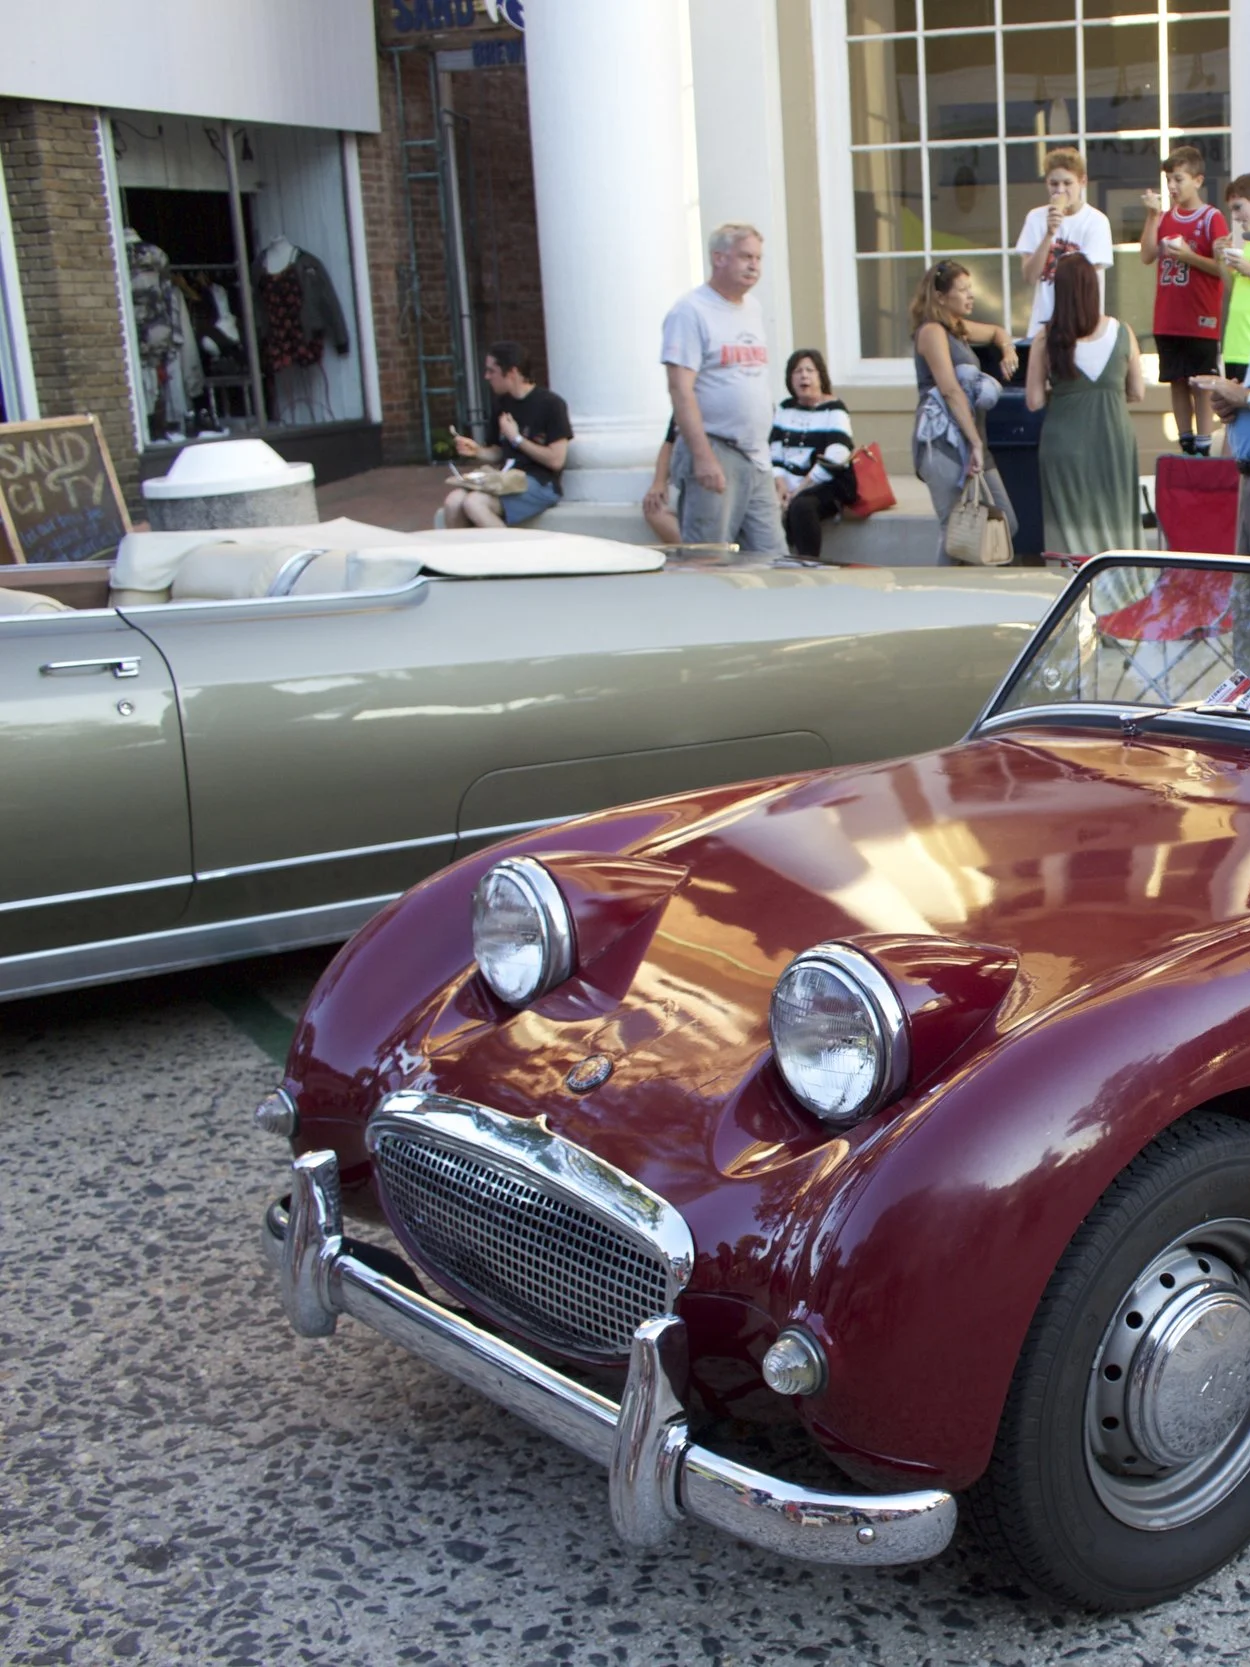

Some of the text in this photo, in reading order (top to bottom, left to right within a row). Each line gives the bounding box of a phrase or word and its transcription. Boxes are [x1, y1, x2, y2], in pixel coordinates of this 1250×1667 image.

[472, 40, 525, 67] BREW
[1160, 258, 1190, 287] 23
[0, 431, 90, 480] SAND
[8, 472, 105, 515] CITY
